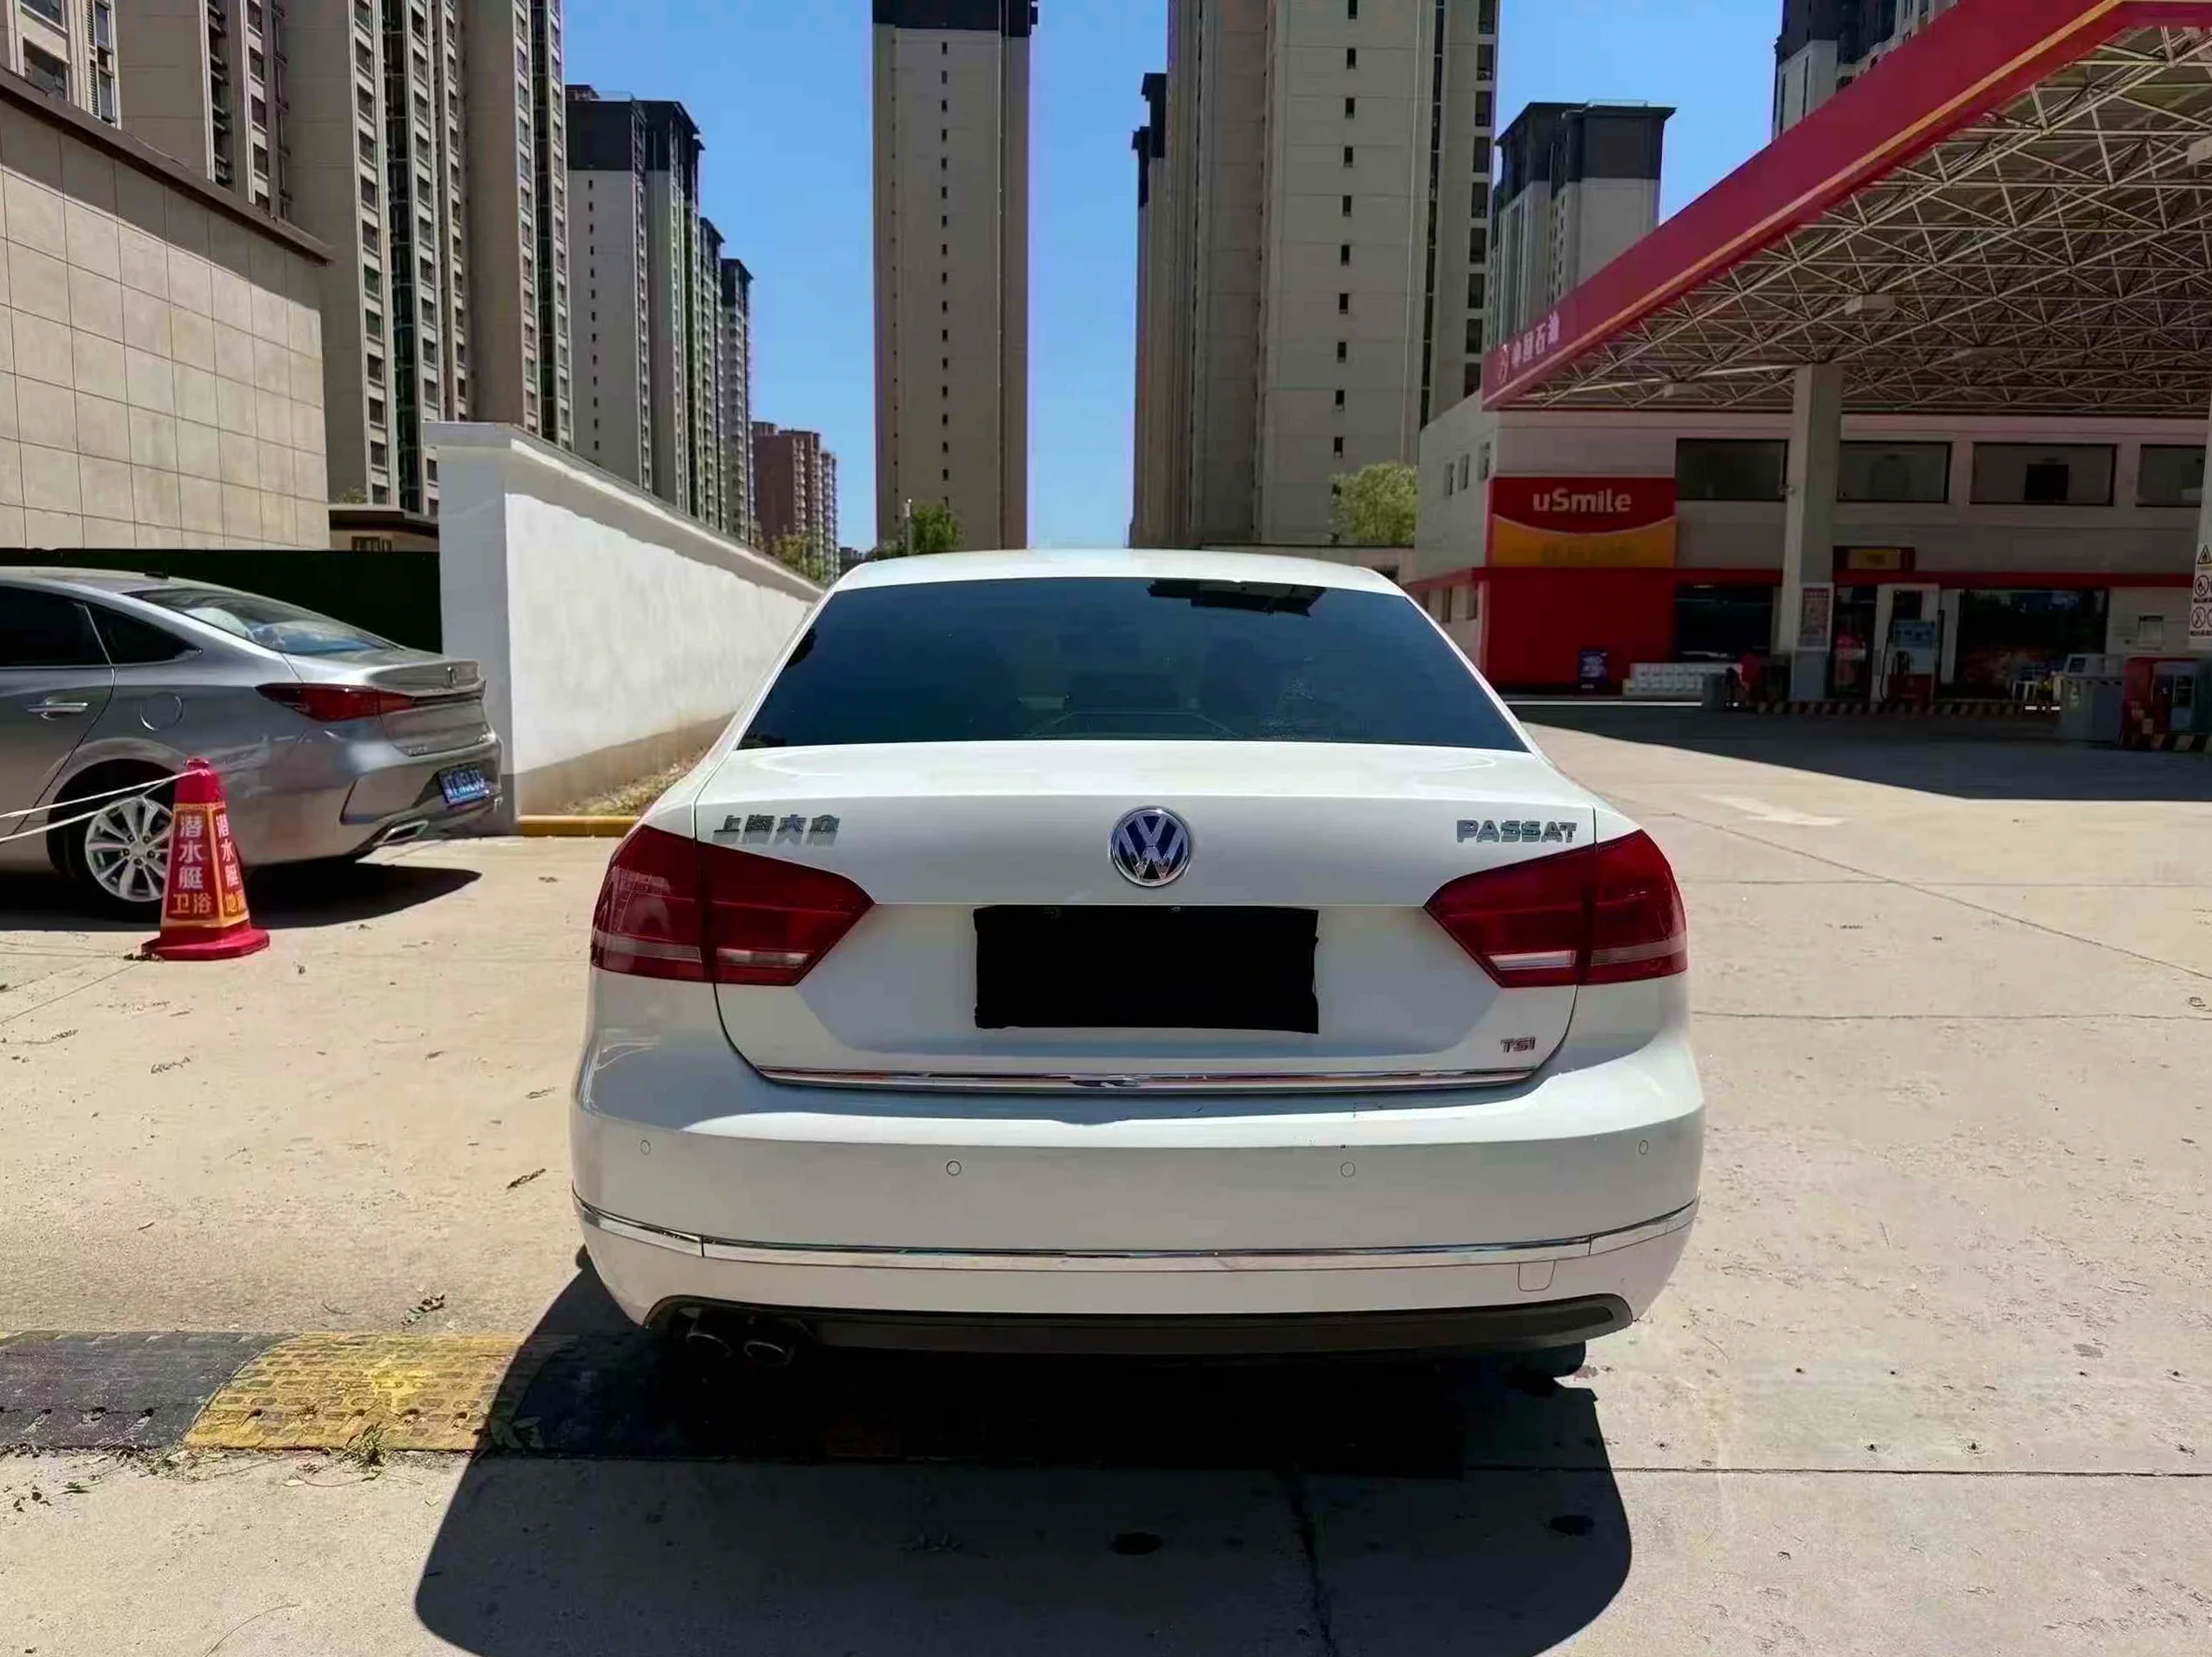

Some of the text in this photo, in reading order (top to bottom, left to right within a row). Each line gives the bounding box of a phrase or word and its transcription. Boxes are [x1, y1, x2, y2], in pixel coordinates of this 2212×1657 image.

[1532, 487, 1632, 512] uSmile
[714, 814, 840, 836] 上海大众
[1457, 820, 1577, 842] PASSAT
[169, 893, 211, 914] 卫浴
[1500, 1036, 1536, 1053] TSI
